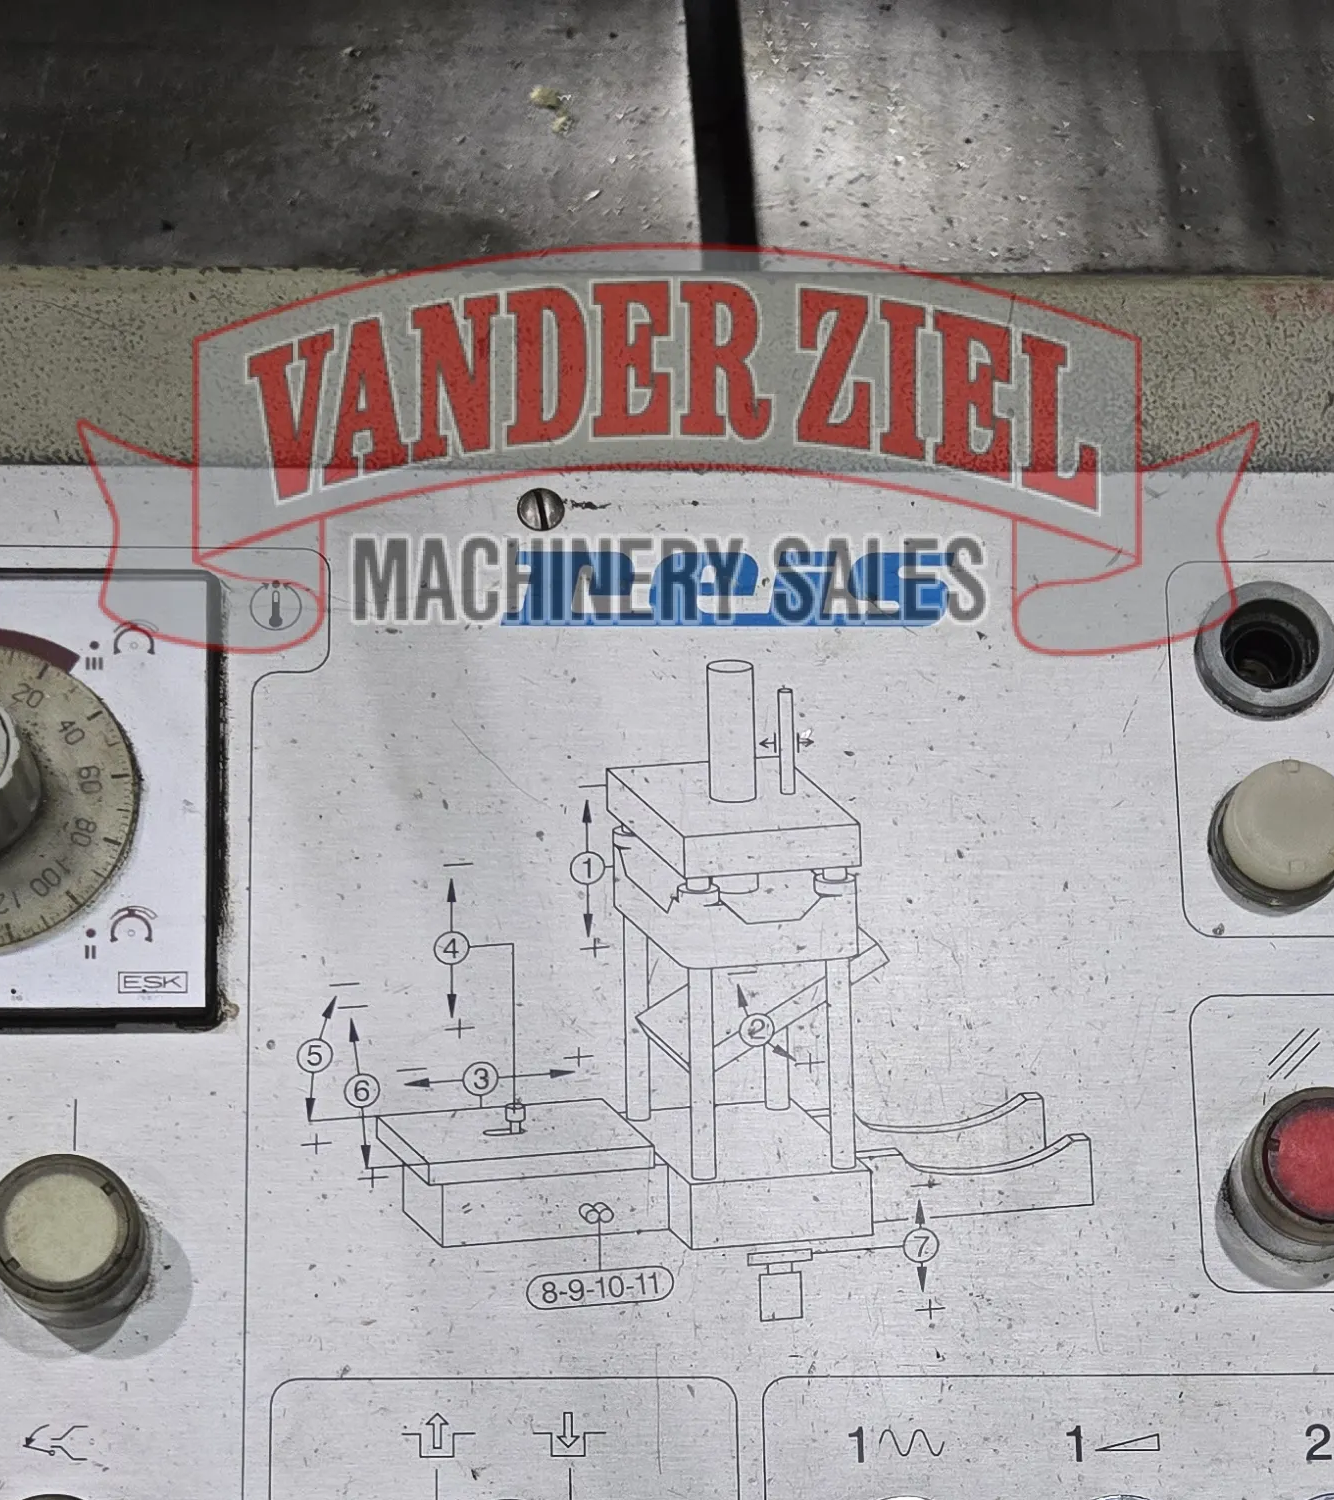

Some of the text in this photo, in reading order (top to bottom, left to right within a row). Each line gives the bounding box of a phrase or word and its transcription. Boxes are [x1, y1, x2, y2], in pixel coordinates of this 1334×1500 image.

[12, 682, 44, 708] 20
[58, 719, 85, 745] 40
[78, 765, 102, 794] 60
[70, 817, 97, 847] 80
[30, 858, 71, 897] 100
[582, 859, 593, 876] 1
[443, 940, 459, 958] 4
[123, 975, 182, 989] ESK
[749, 1020, 766, 1039] 2
[307, 1046, 323, 1066] 5
[353, 1081, 370, 1102] 6
[473, 1068, 490, 1090] 3
[914, 1235, 931, 1258] 7
[541, 1270, 662, 1304] 8-9-10-11
[849, 1426, 864, 1461] 1
[1067, 1426, 1084, 1461] 1
[1305, 1423, 1331, 1459] 2
